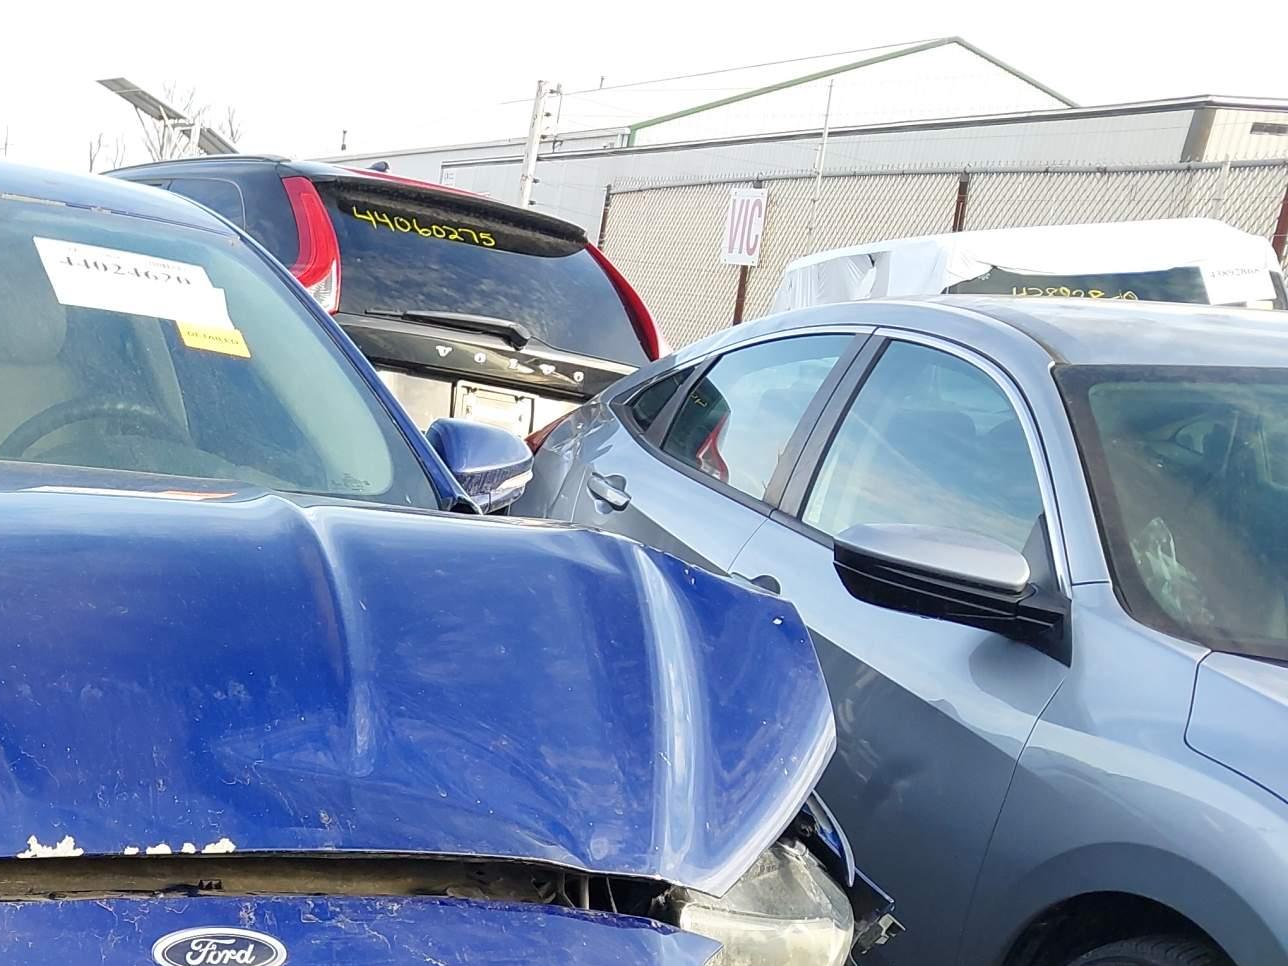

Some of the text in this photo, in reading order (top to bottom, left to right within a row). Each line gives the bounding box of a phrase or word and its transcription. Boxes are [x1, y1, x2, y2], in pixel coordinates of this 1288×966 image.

[352, 206, 496, 247] 44060275
[728, 198, 763, 256] VIC
[185, 938, 256, 966] Ford
